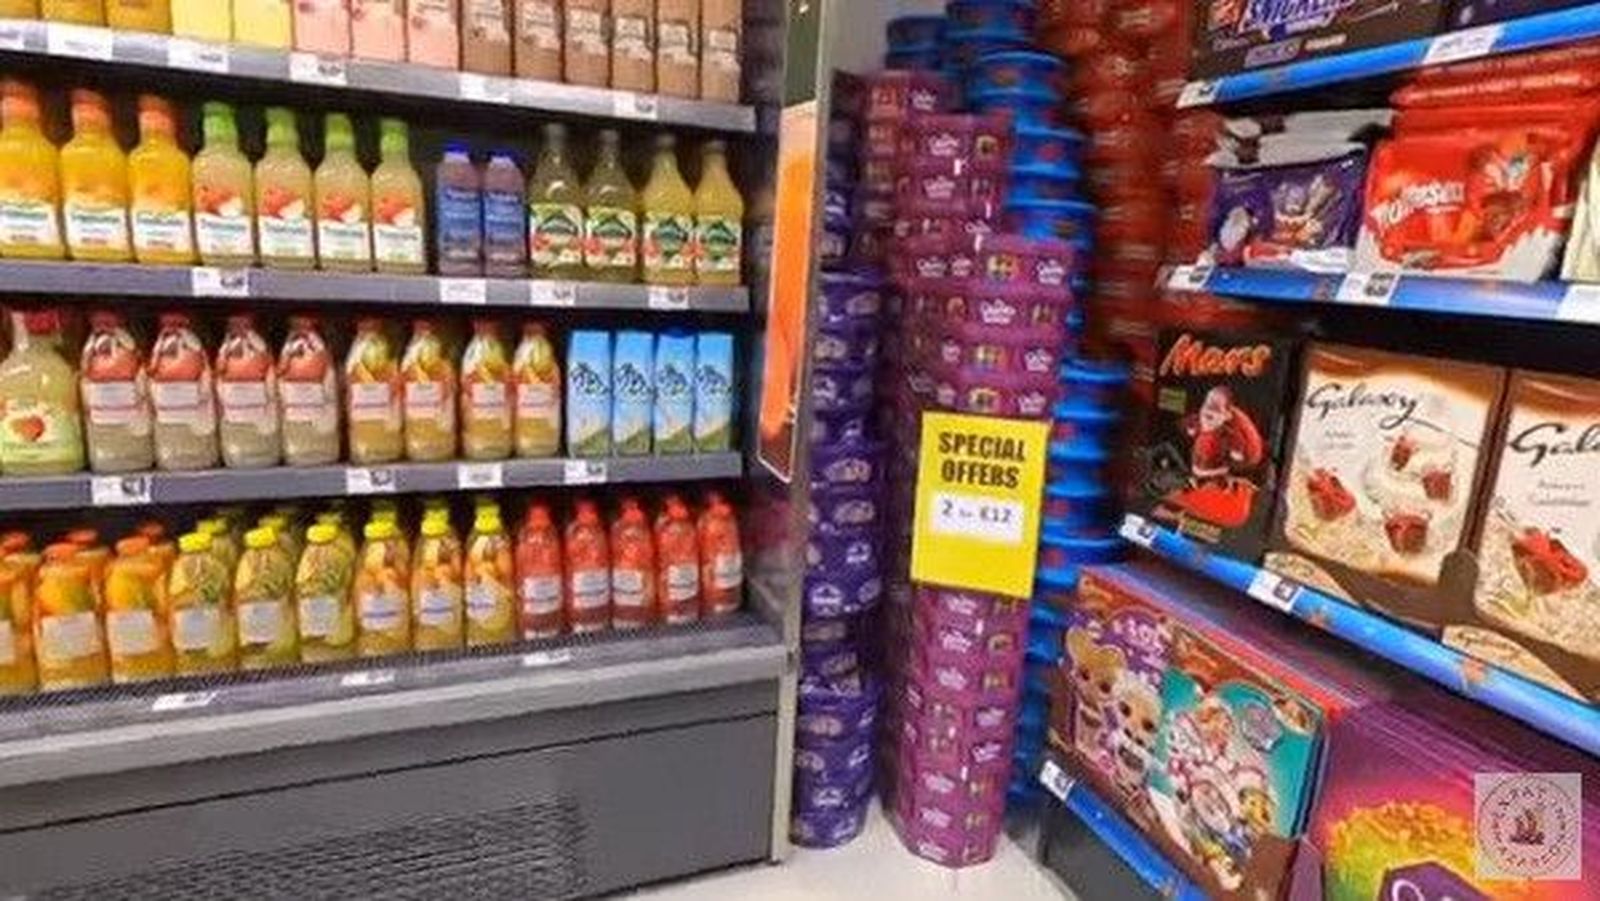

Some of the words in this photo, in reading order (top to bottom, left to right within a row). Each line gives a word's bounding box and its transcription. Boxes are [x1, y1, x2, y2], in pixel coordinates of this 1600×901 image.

[1159, 333, 1271, 378] Mars
[1306, 382, 1420, 440] Galaxy
[938, 431, 1026, 461] SPECIAL
[941, 458, 1019, 489] OFFERS
[941, 499, 953, 517] 2
